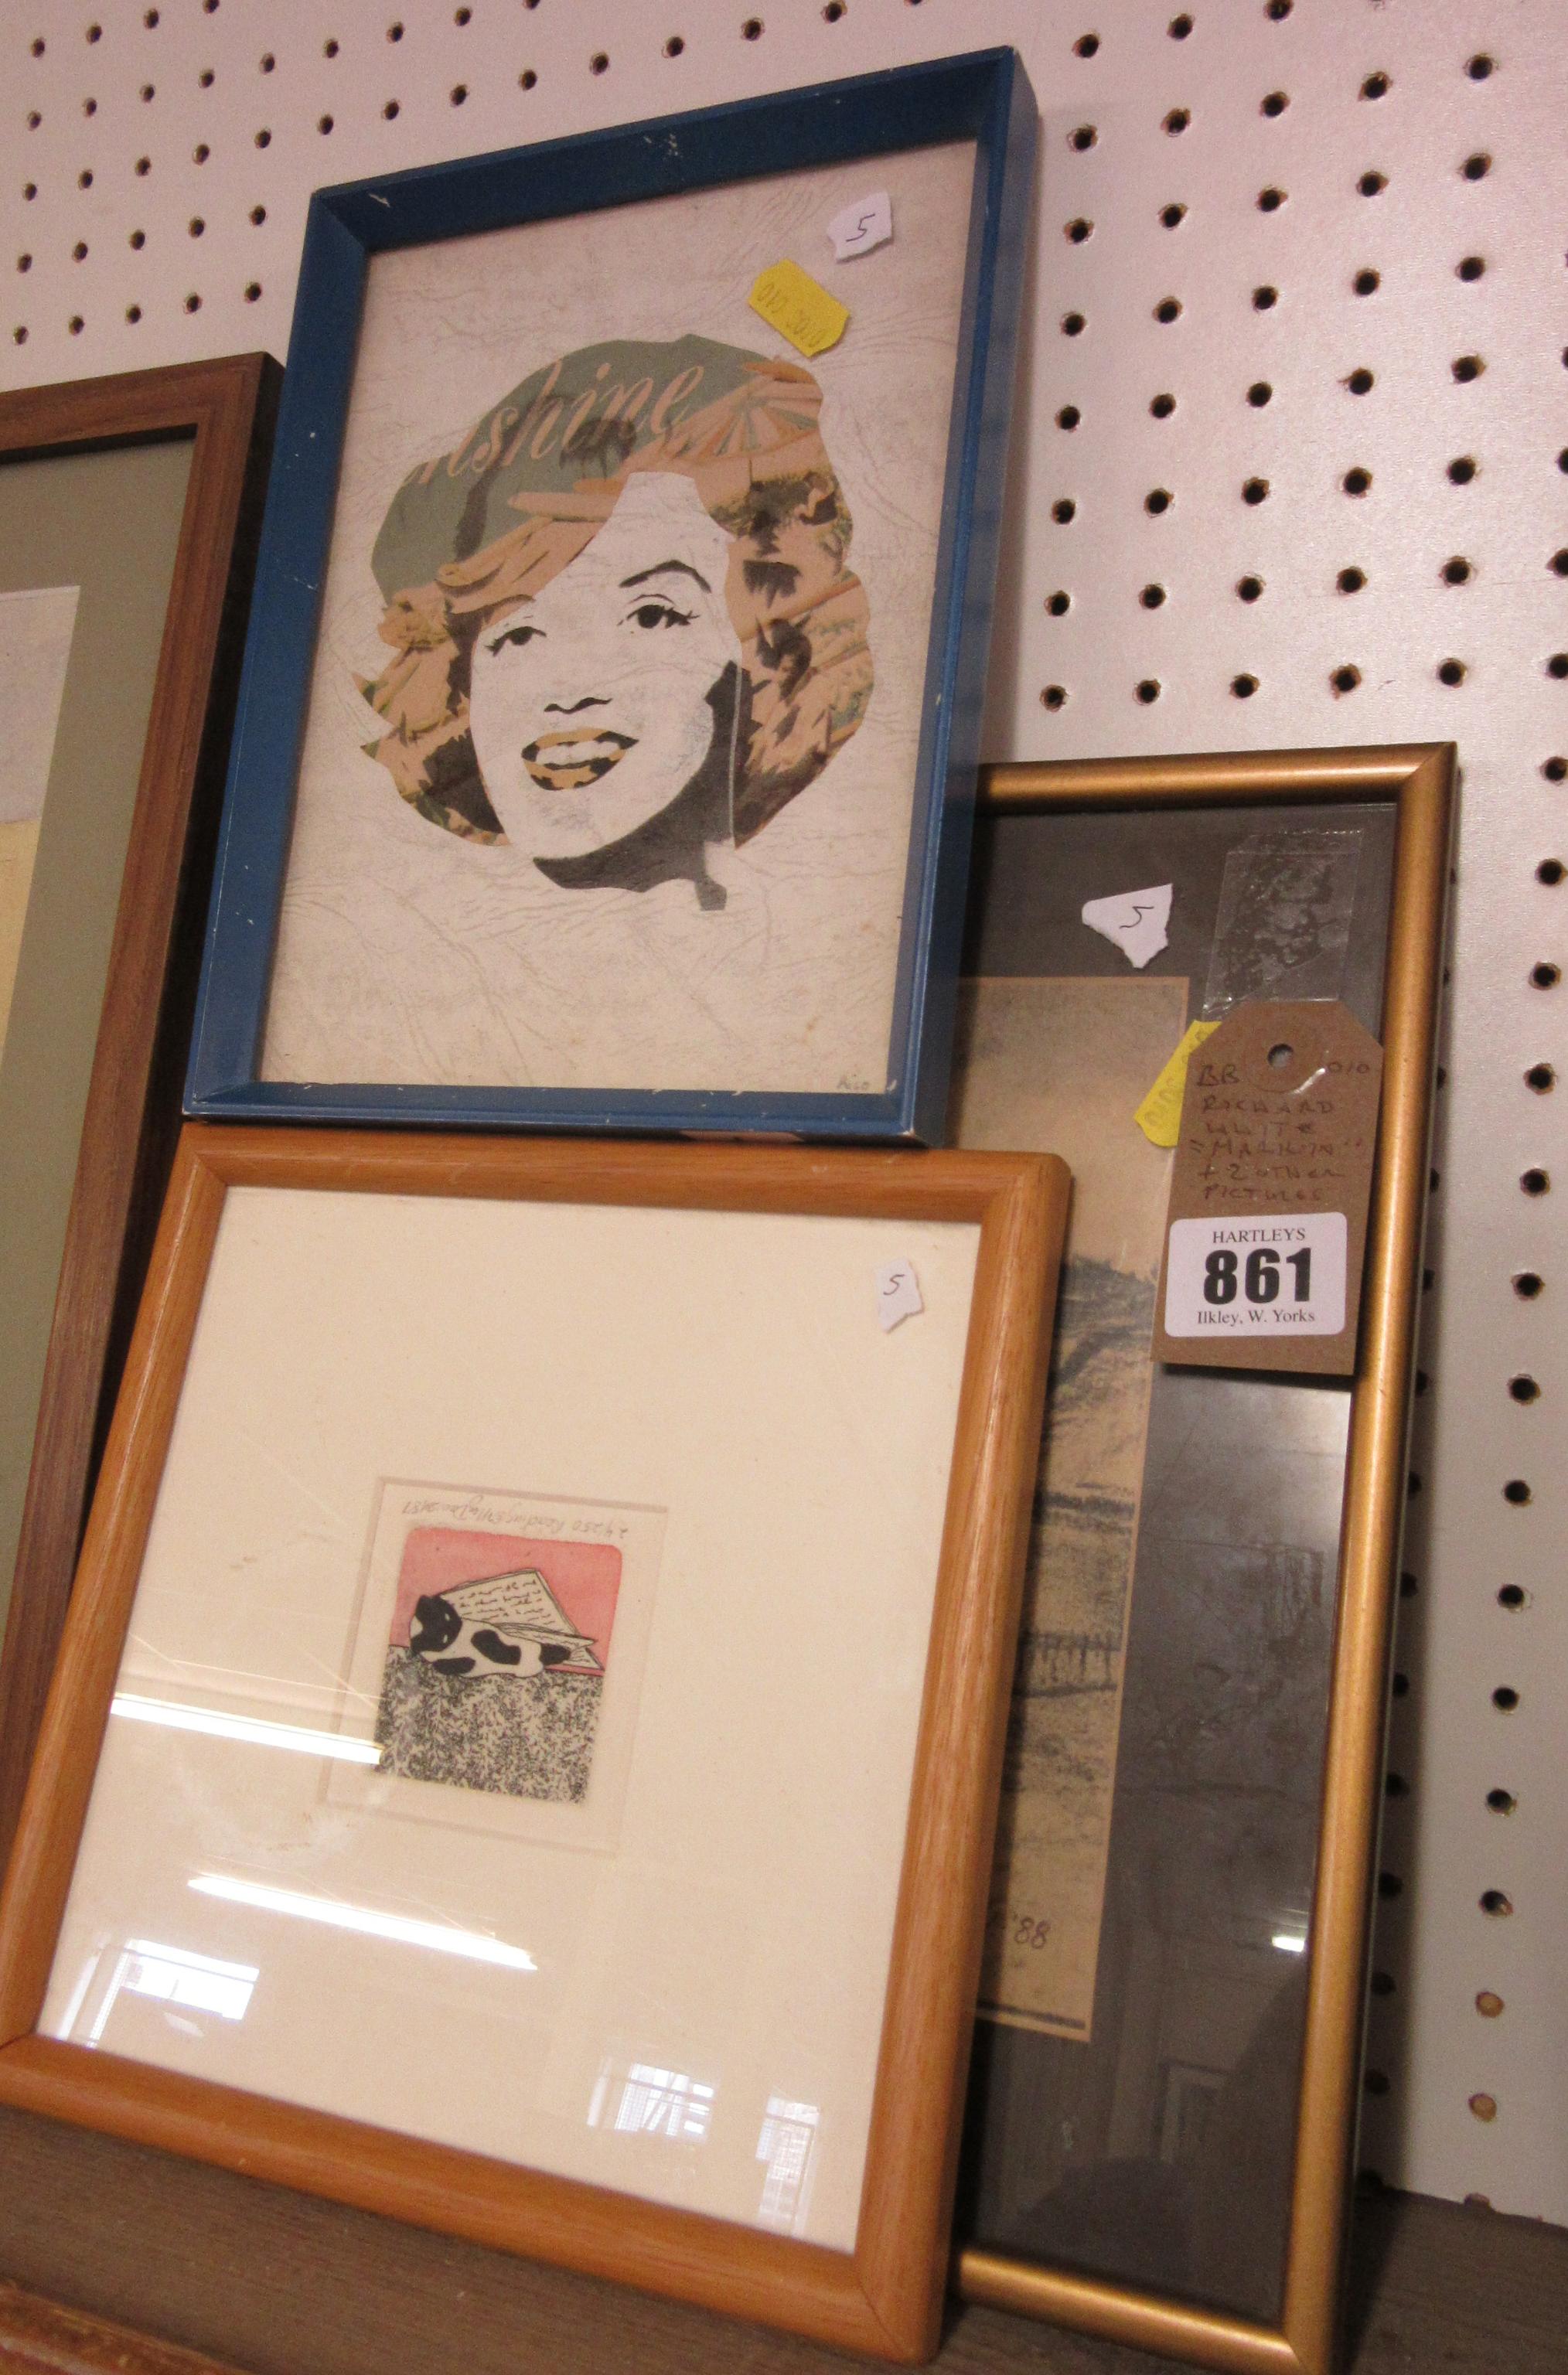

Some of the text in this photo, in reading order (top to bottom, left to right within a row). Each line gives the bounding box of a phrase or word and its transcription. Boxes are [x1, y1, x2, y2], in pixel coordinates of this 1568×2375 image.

[845, 213, 876, 243] 5
[1119, 905, 1155, 929] 5
[1228, 1163, 1247, 1181] 2
[1212, 1228, 1307, 1245] HARTLEYS
[1203, 1247, 1312, 1305] 861
[1197, 1309, 1315, 1326] Ilkley, W. Yorks
